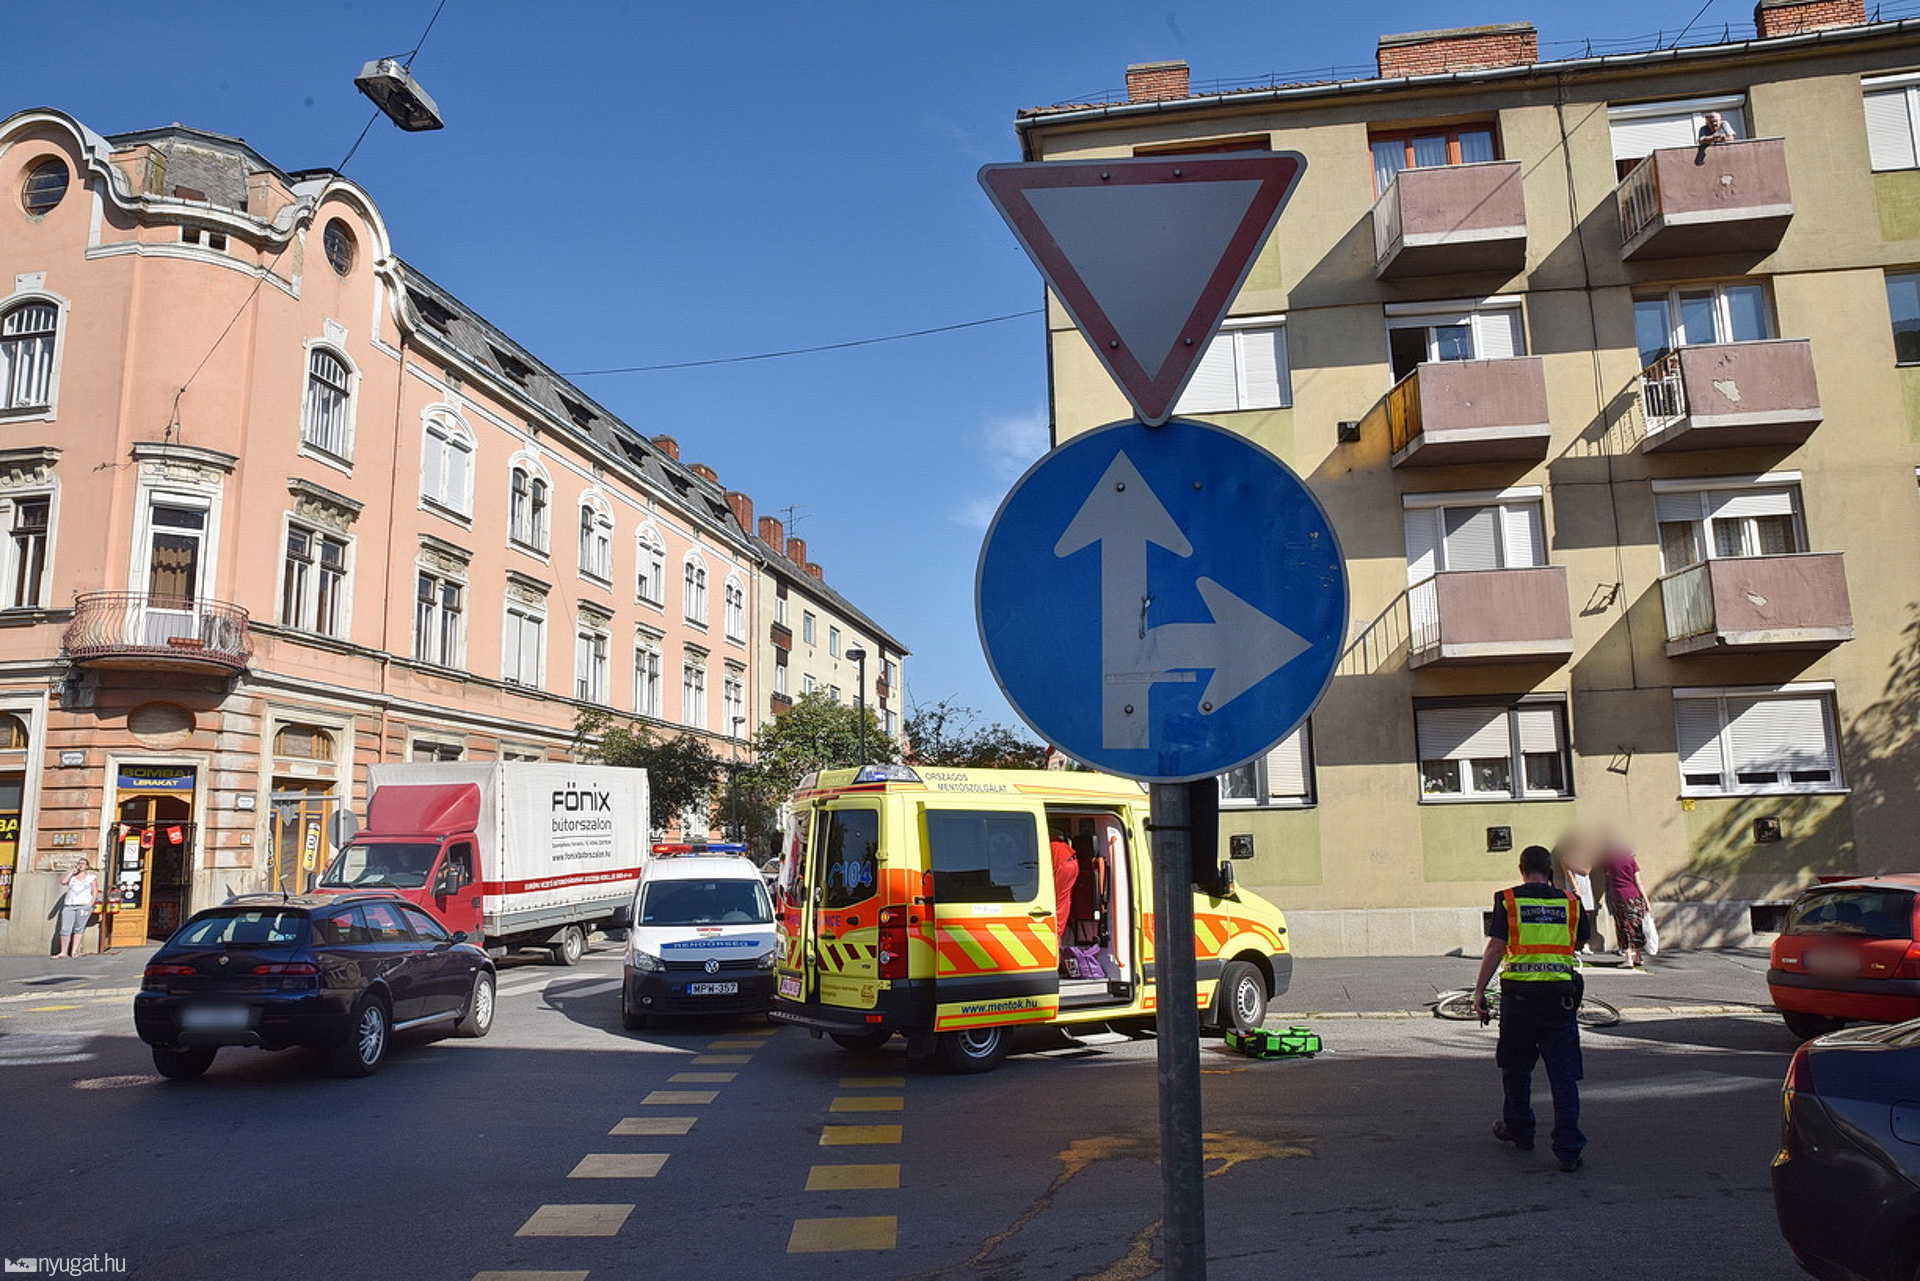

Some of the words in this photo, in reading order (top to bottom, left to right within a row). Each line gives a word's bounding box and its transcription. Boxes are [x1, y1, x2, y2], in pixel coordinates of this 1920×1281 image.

[552, 817, 612, 832] bútorszalon
[693, 983, 737, 993] MPW-357
[961, 998, 1038, 1014] www.mentok.hu
